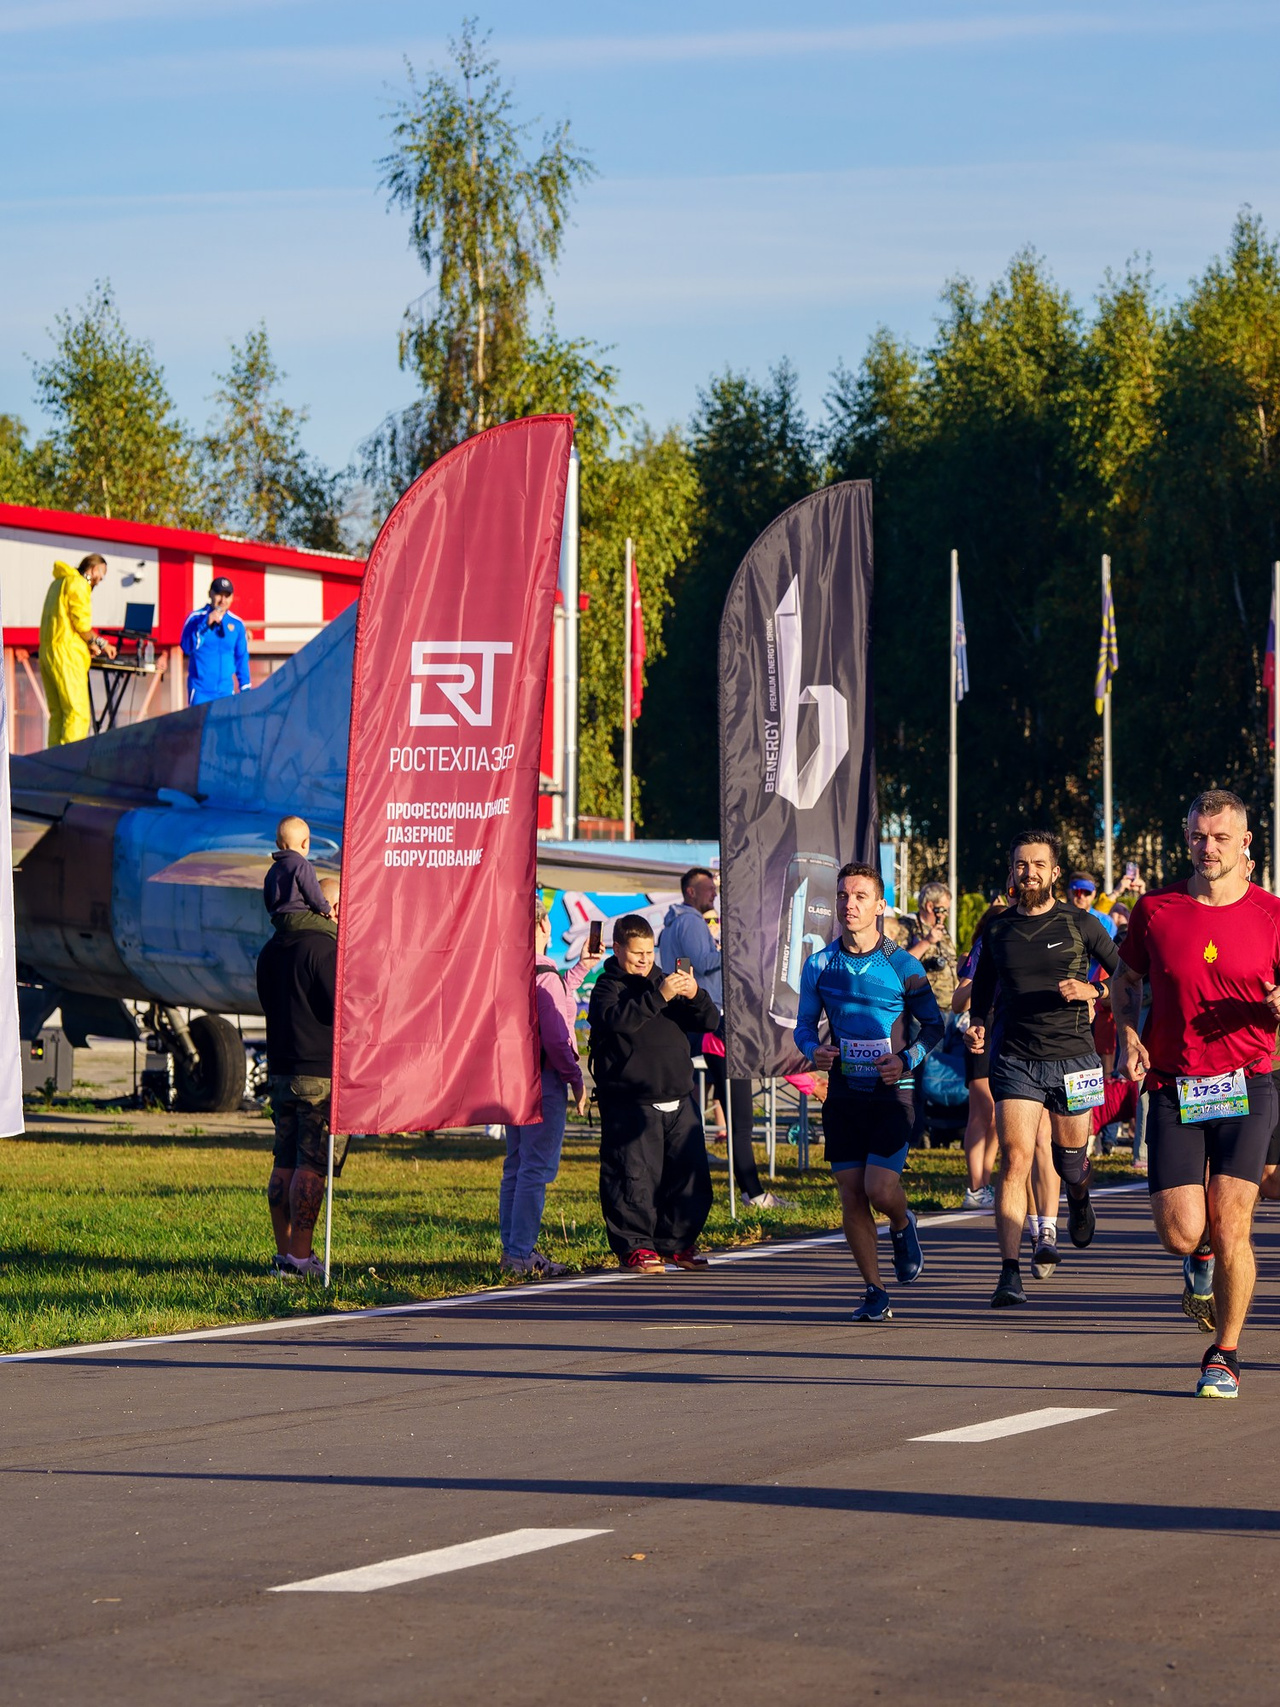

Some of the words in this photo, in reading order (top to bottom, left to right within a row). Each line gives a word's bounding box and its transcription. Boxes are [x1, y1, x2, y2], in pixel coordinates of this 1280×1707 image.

[766, 618, 774, 641] DRINK
[768, 643, 776, 675] ENERGY
[769, 677, 778, 712] PREMIUM
[389, 743, 515, 772] РОСТЕХЛАЗЕР
[764, 719, 779, 793] BENERGY
[386, 797, 510, 820] ПРОФЕССИОНАЛЬНОЕ
[385, 826, 454, 843] ЛАЗЕРНОЕ
[808, 905, 832, 917] CLASSIC
[781, 944, 790, 983] BENERGY
[849, 1049, 881, 1058] 1700
[1192, 1081, 1232, 1098] 1733
